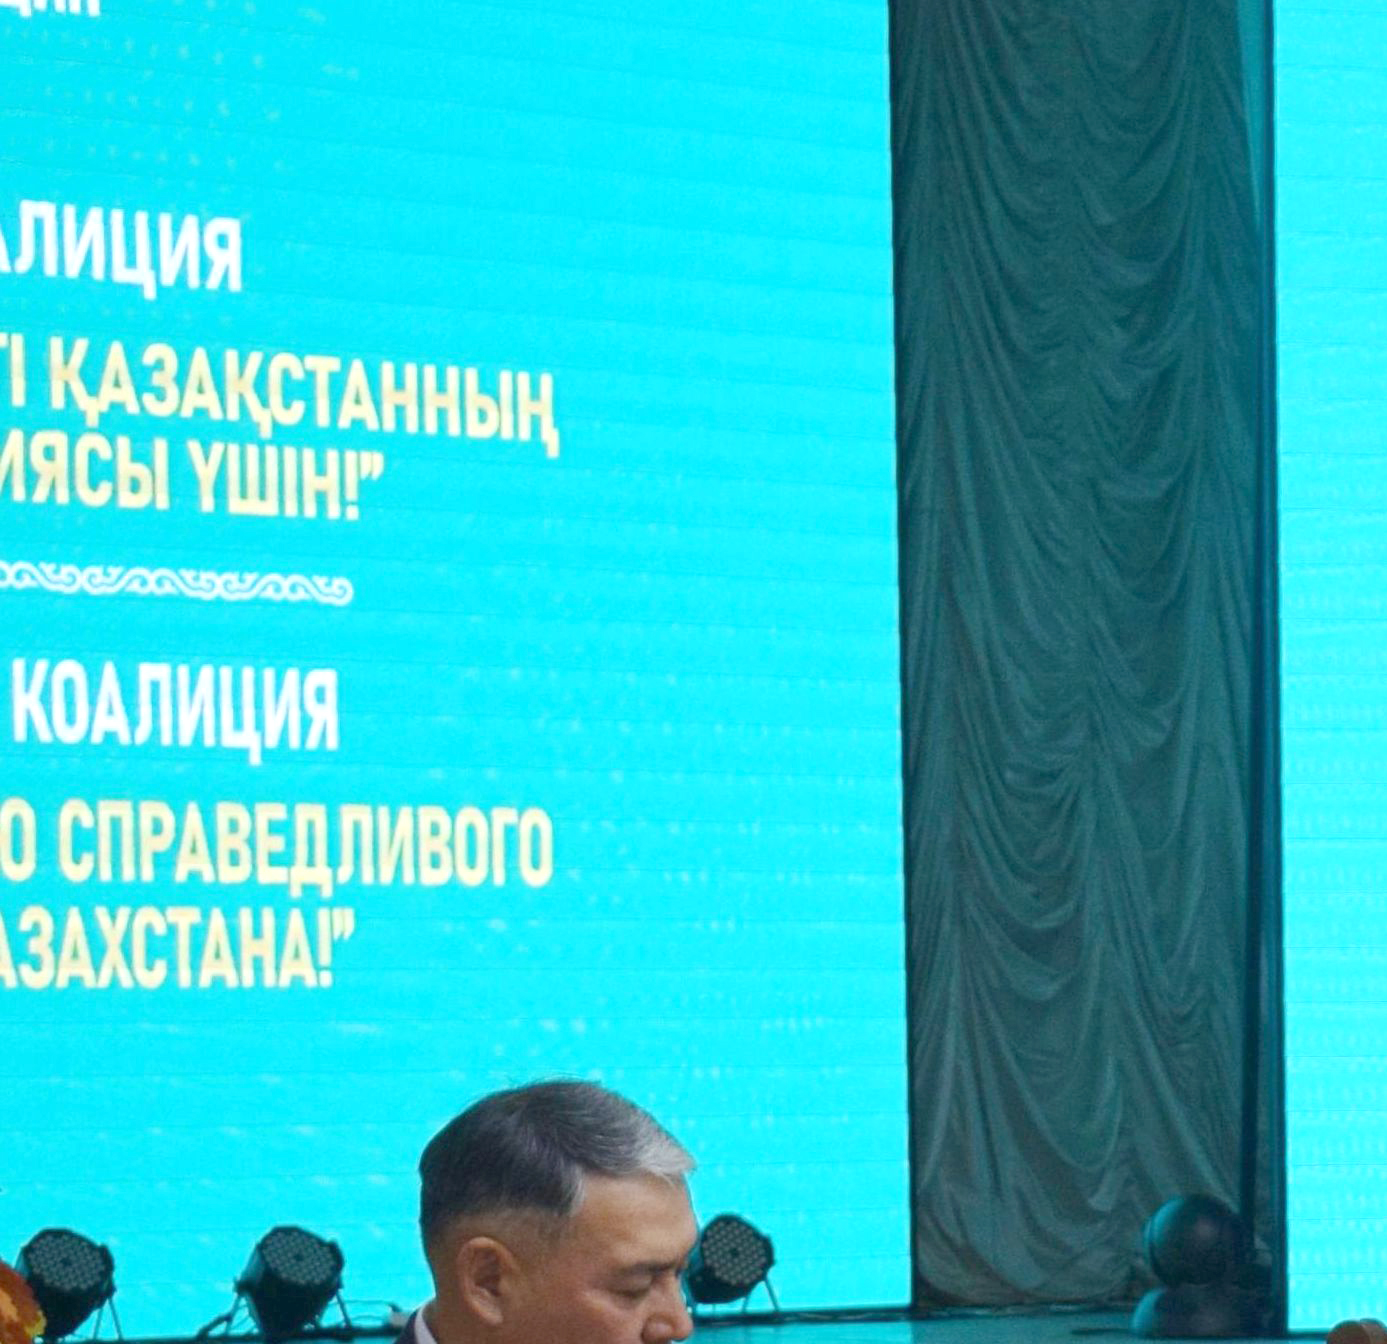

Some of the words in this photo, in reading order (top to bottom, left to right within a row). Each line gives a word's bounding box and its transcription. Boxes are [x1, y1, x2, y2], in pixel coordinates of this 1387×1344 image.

[48, 335, 560, 459] ҚАЗАҚСТАННЫҢ
[11, 657, 339, 767] КОАЛИЦИЯ
[0, 797, 37, 883] О
[57, 797, 554, 899] СПРАВЕДЛИВОГО
